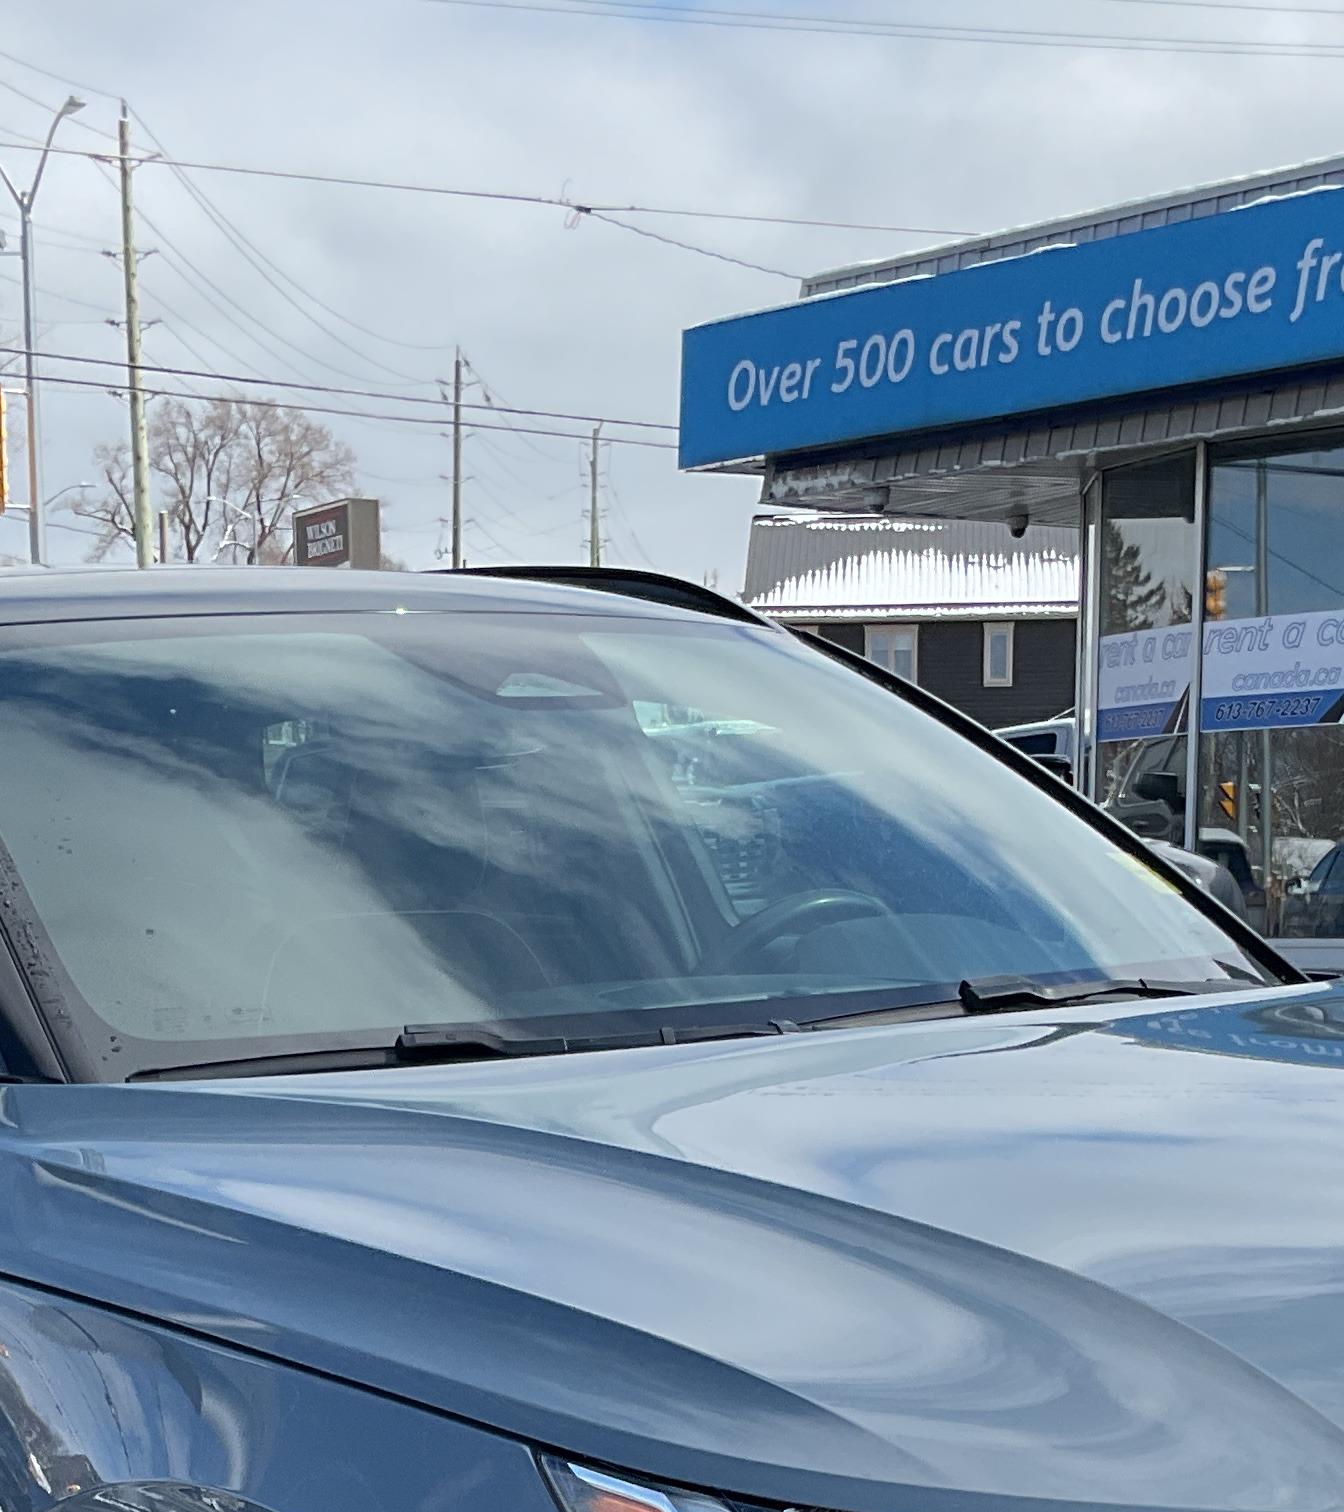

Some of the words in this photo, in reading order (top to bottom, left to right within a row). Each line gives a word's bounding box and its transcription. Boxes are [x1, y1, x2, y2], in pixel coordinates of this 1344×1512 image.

[727, 353, 821, 412] Over
[830, 327, 915, 393] 500
[928, 318, 1019, 376] cars
[1036, 300, 1084, 356] to
[1100, 268, 1276, 342] choose
[1142, 636, 1157, 663] a
[1203, 617, 1274, 656] rent
[1282, 621, 1306, 649] a
[1232, 662, 1342, 693] canada.ca
[1215, 696, 1322, 722] 613-767-2237
